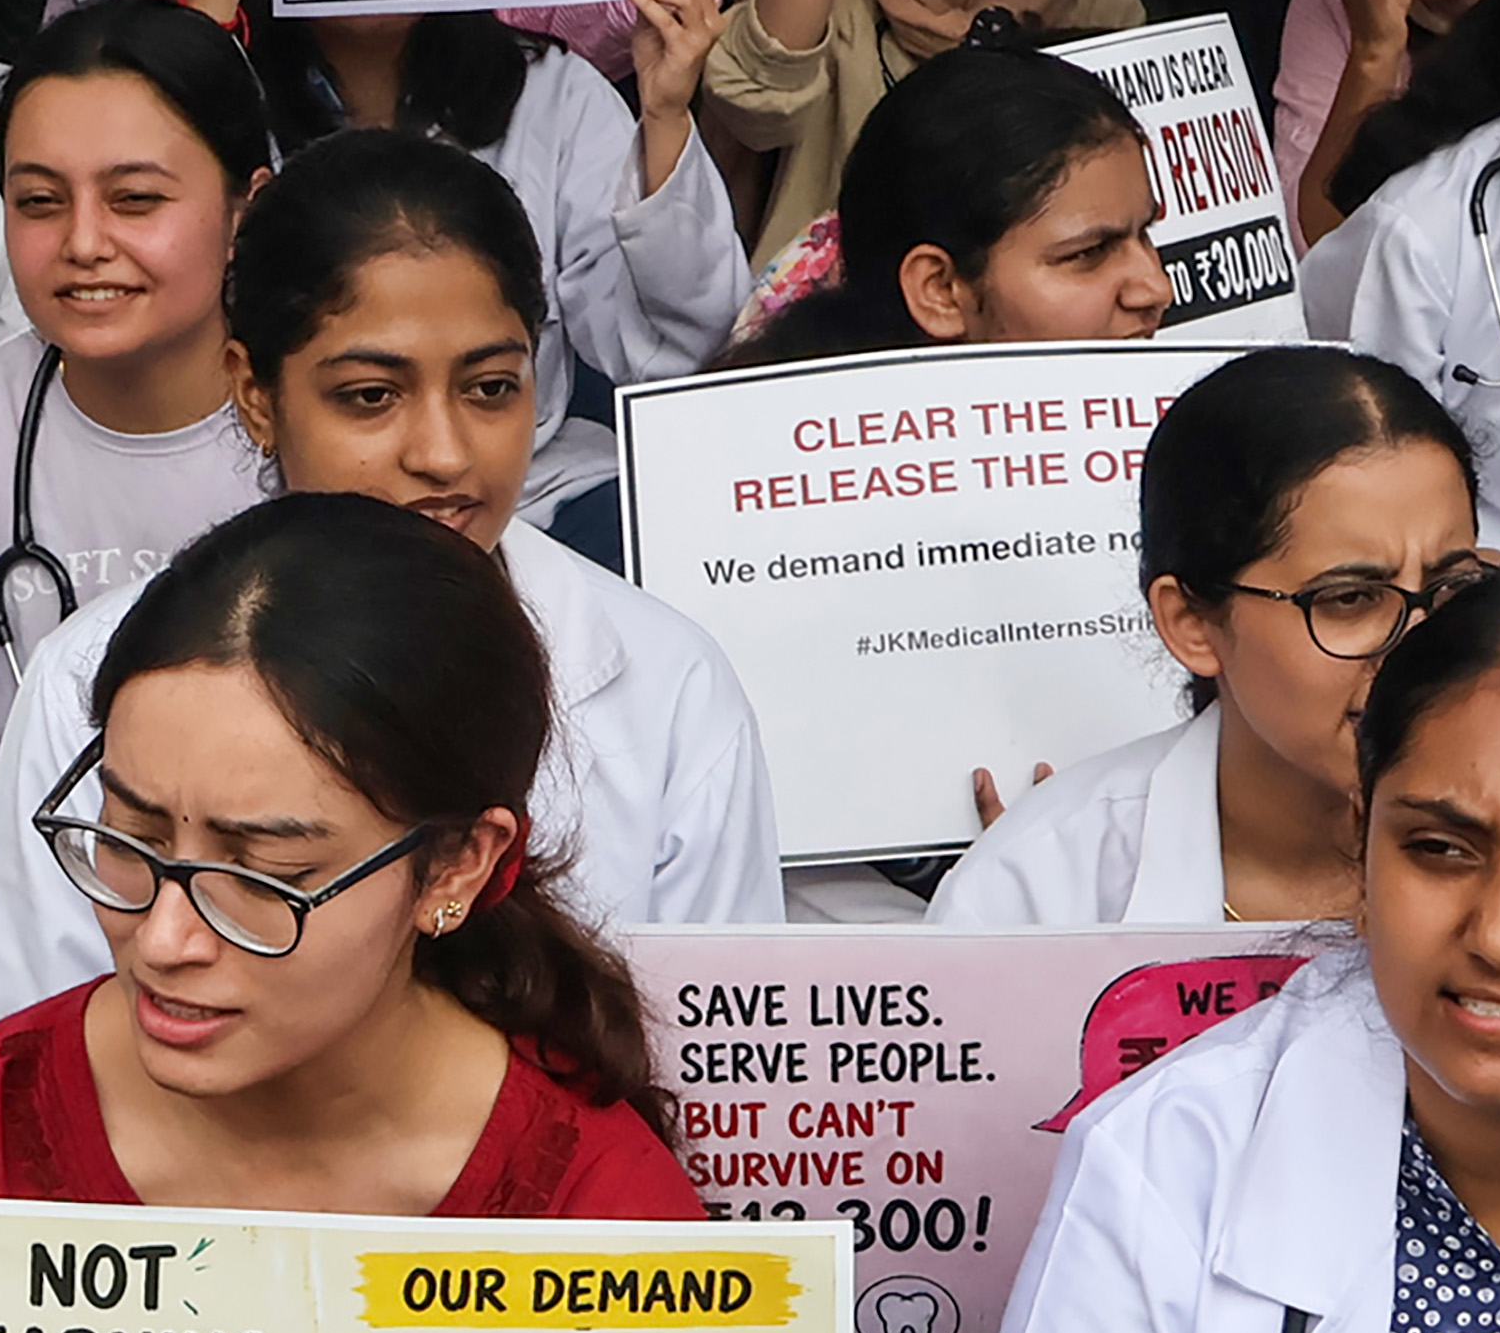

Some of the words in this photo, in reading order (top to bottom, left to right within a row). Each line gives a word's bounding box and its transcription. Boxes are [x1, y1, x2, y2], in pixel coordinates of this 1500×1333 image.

[1163, 54, 1185, 99] IS
[1182, 45, 1234, 96] CLEAR
[1161, 107, 1273, 216] REVISION
[1166, 260, 1193, 306] TO
[1195, 225, 1289, 302] ₹30,000
[792, 407, 957, 454] CLEAR
[972, 399, 1068, 436] THE
[733, 465, 959, 514] RELEASE
[974, 453, 1069, 492] THE
[703, 558, 758, 586] We
[767, 544, 906, 582] demand
[916, 529, 1097, 568] immediate
[677, 984, 788, 1028] SAVE
[809, 984, 944, 1028] LIVES.
[679, 1041, 808, 1085] SERVE
[830, 1041, 998, 1085] PEOPLE.
[684, 1102, 767, 1139] BUT
[788, 1101, 916, 1140] CAN'T
[686, 1151, 866, 1187] SURVIVE
[886, 1149, 944, 1186] ON
[28, 1245, 178, 1311] NOT
[401, 1266, 508, 1314] OUR
[531, 1269, 754, 1316] DEMAND
